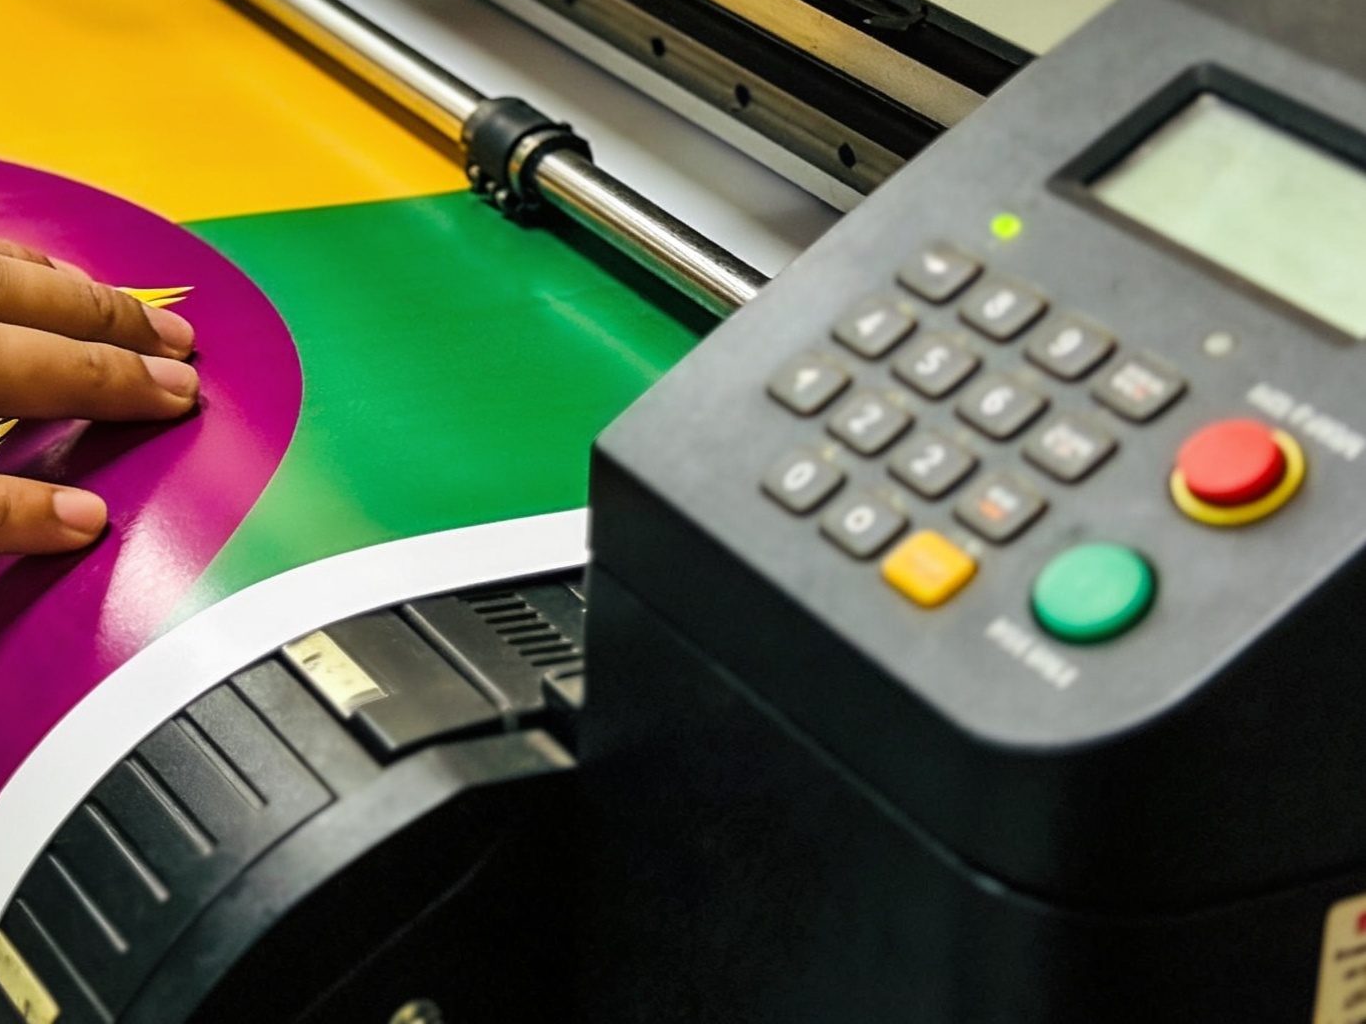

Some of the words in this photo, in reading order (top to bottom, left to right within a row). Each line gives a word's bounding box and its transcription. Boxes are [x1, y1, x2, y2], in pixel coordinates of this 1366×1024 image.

[915, 346, 949, 375] 5
[981, 387, 1014, 416] 6
[847, 403, 883, 434] 2
[910, 444, 946, 474] 2
